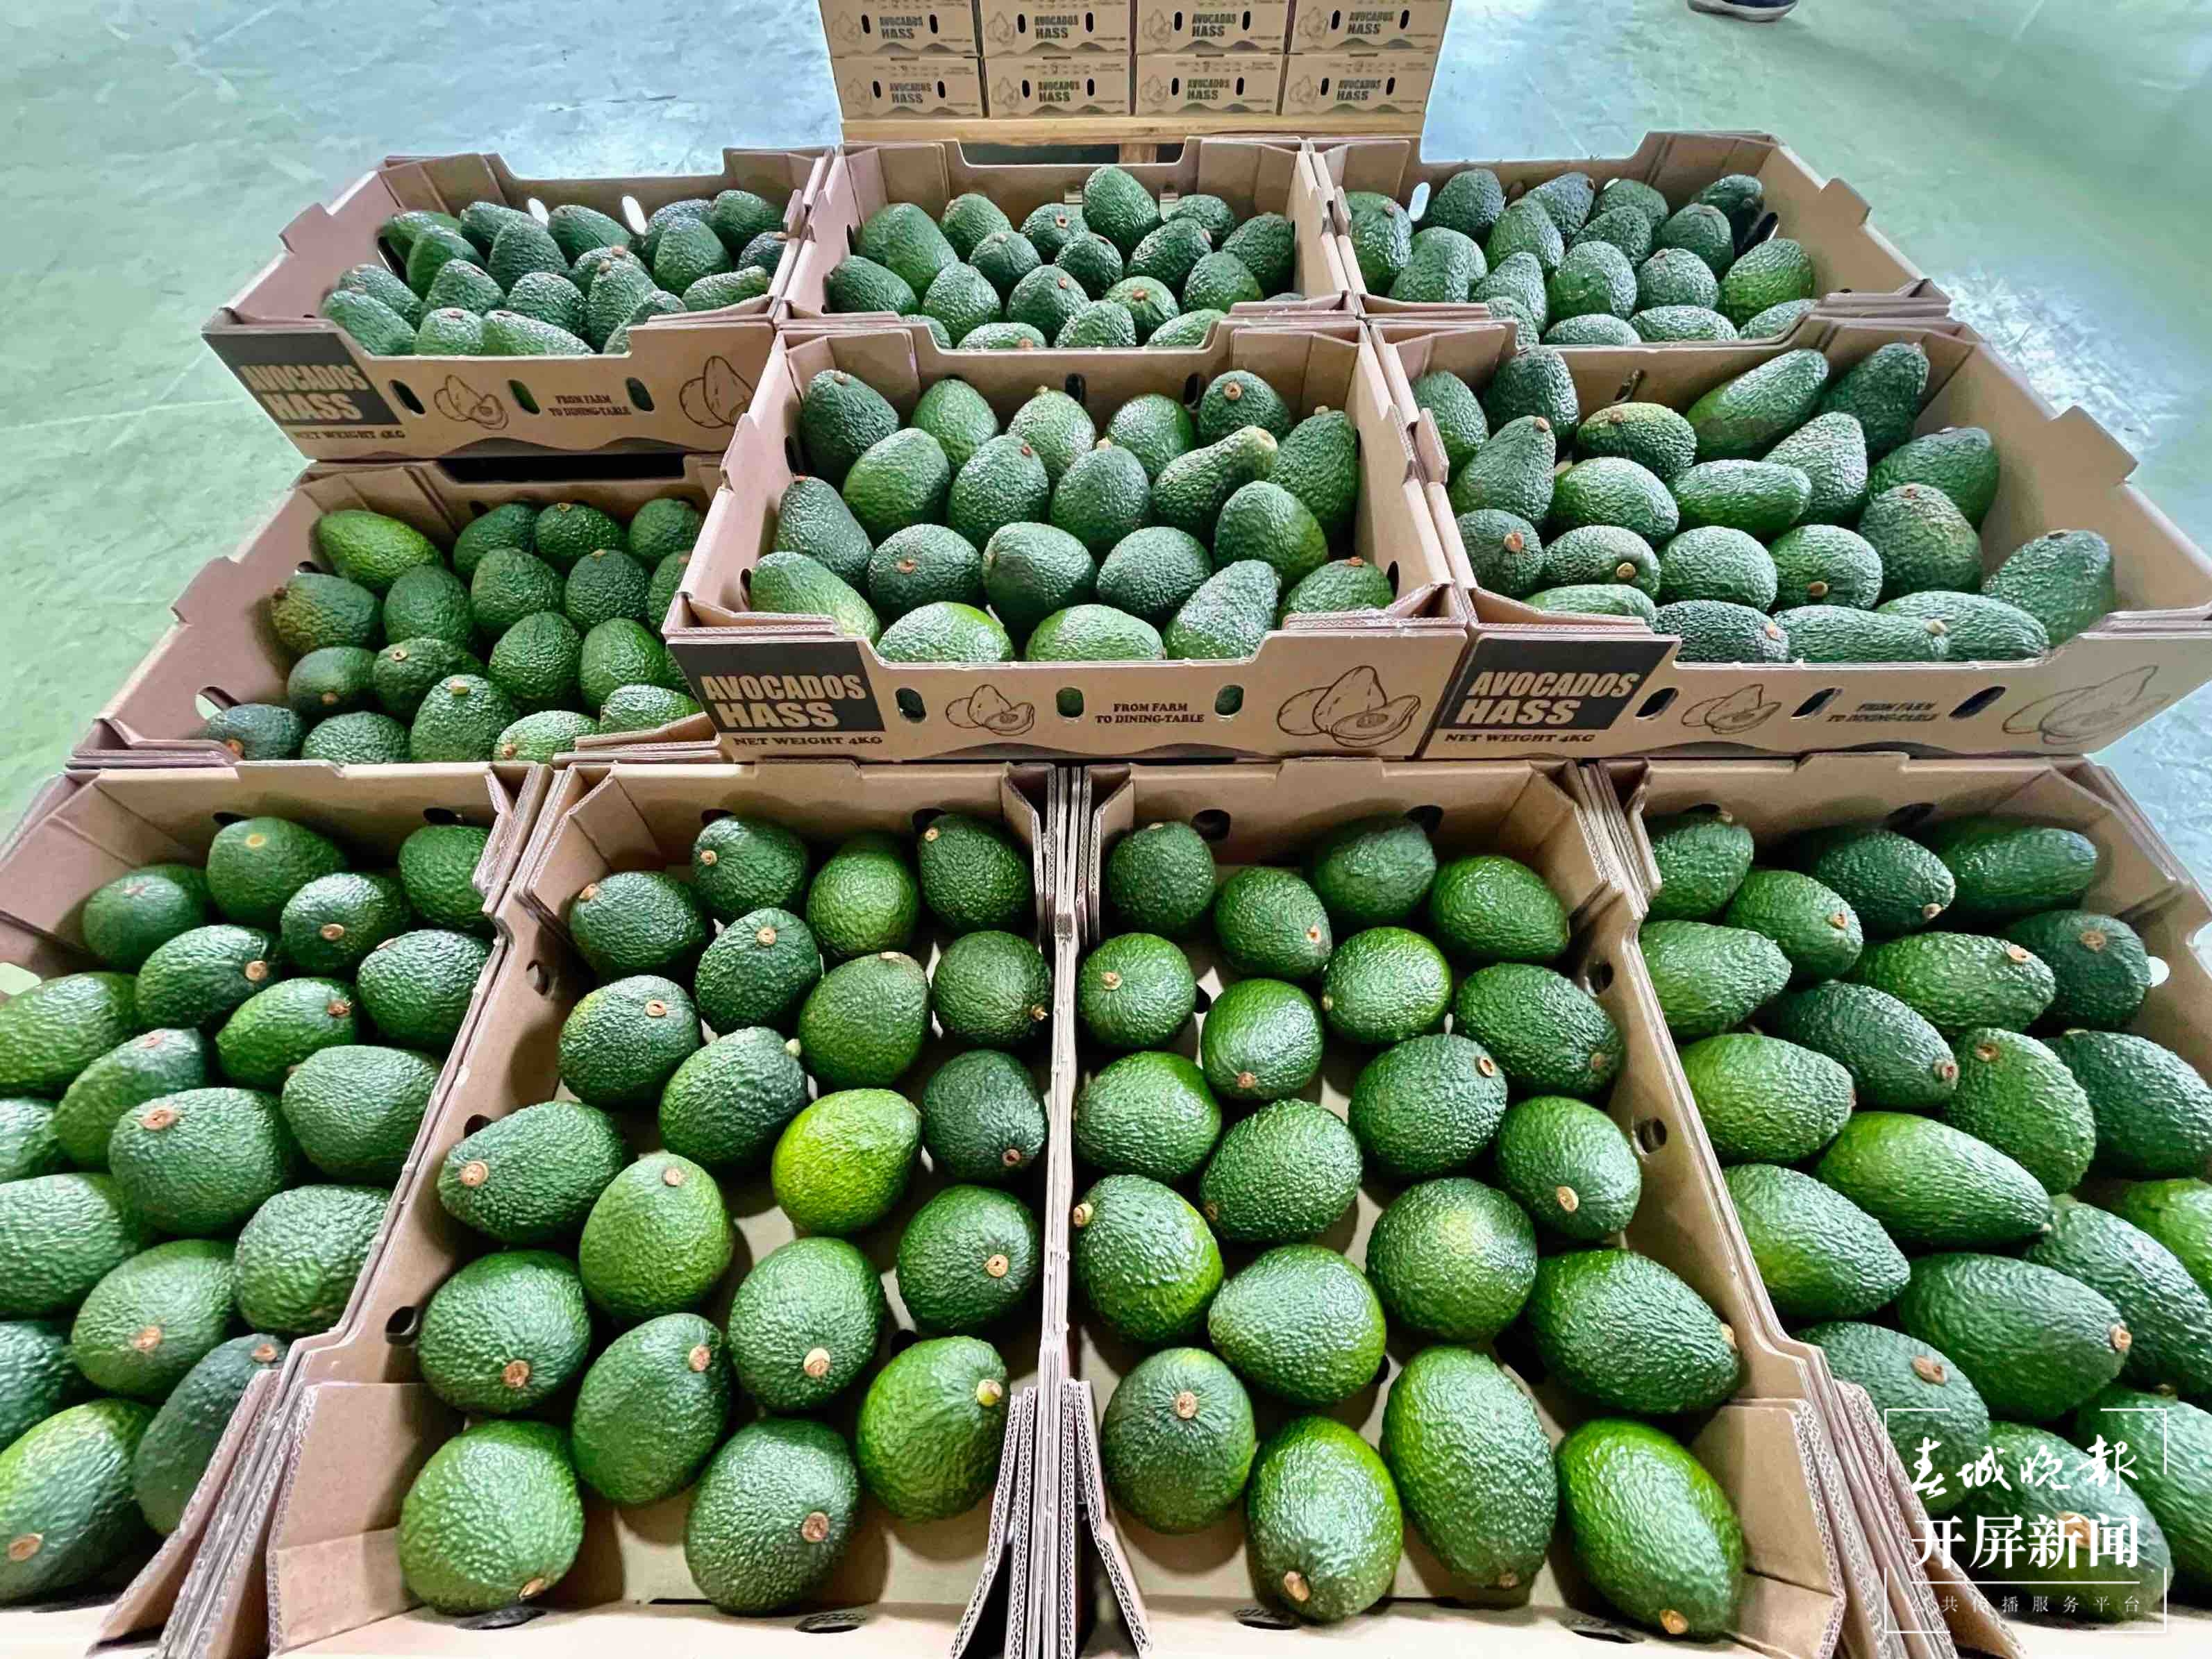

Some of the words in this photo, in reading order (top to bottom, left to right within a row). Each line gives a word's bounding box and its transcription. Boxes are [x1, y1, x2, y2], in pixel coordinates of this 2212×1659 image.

[881, 28, 915, 39] HASS
[1036, 28, 1069, 39] HASS
[1192, 25, 1225, 37] HASS
[1348, 23, 1380, 35] HASS
[891, 94, 923, 103] HASS
[1039, 92, 1071, 102] HASS
[1187, 90, 1218, 100] HASS
[1337, 90, 1368, 101] HASS
[239, 364, 370, 391] AVOCADOS
[260, 393, 363, 420] HASS
[294, 431, 321, 439] NET
[322, 430, 376, 439] WEIGHT
[700, 675, 866, 700] AVOCADOS
[1466, 671, 1639, 698] AVOCADOS
[1113, 703, 1149, 712] FROM
[1153, 703, 1188, 712] FARM
[1456, 698, 1581, 725] HASS
[714, 702, 839, 728] HASS
[1095, 715, 1114, 724] TO
[1114, 714, 1205, 724] DINING-TABLE
[733, 736, 769, 746] NET
[774, 736, 844, 746] WEIGHT
[848, 736, 883, 746] 4KG
[1445, 733, 1482, 742] NET
[1486, 733, 1555, 742] WEIGHT
[1559, 733, 1596, 742] 4KG
